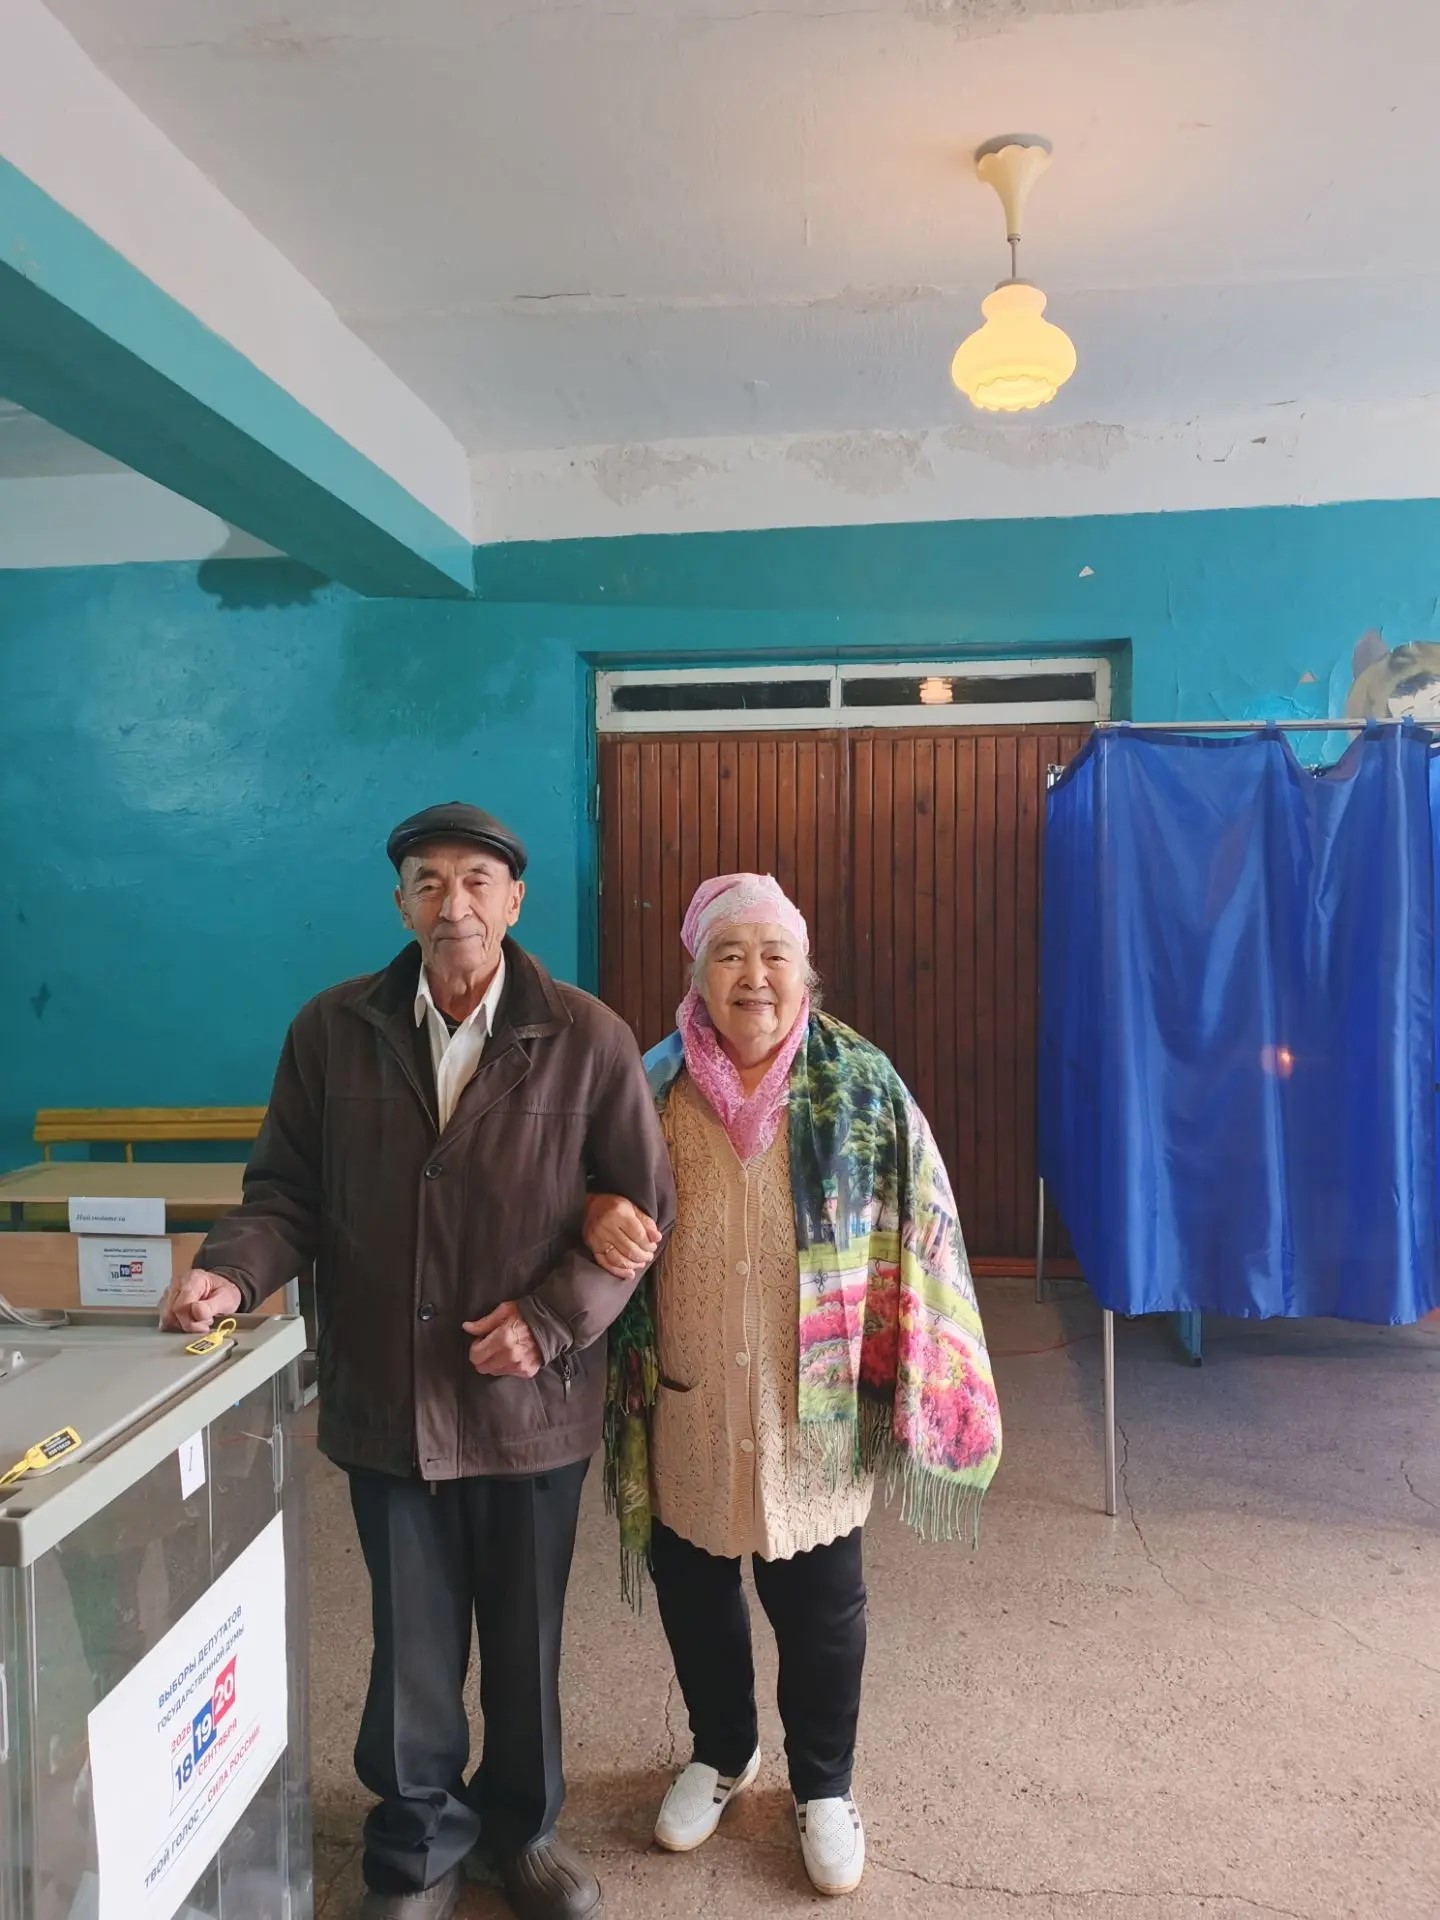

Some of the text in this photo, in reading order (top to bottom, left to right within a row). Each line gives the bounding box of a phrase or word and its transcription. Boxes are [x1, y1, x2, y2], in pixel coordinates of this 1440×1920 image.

[157, 1624, 244, 1733] ГОСУДАРСТВЕННОЙ ДУМЫ
[158, 1605, 242, 1709] ВЫБОРЫ ДЕПУТАТОВ
[171, 1722, 191, 1753] 2026
[175, 1672, 234, 1791] 18 19 20
[198, 1717, 237, 1776] СЕНТЯБРЯ
[144, 1849, 170, 1888] ТВОЙ
[171, 1809, 200, 1855] ГОЛОС
[207, 1769, 229, 1803] СИЛА
